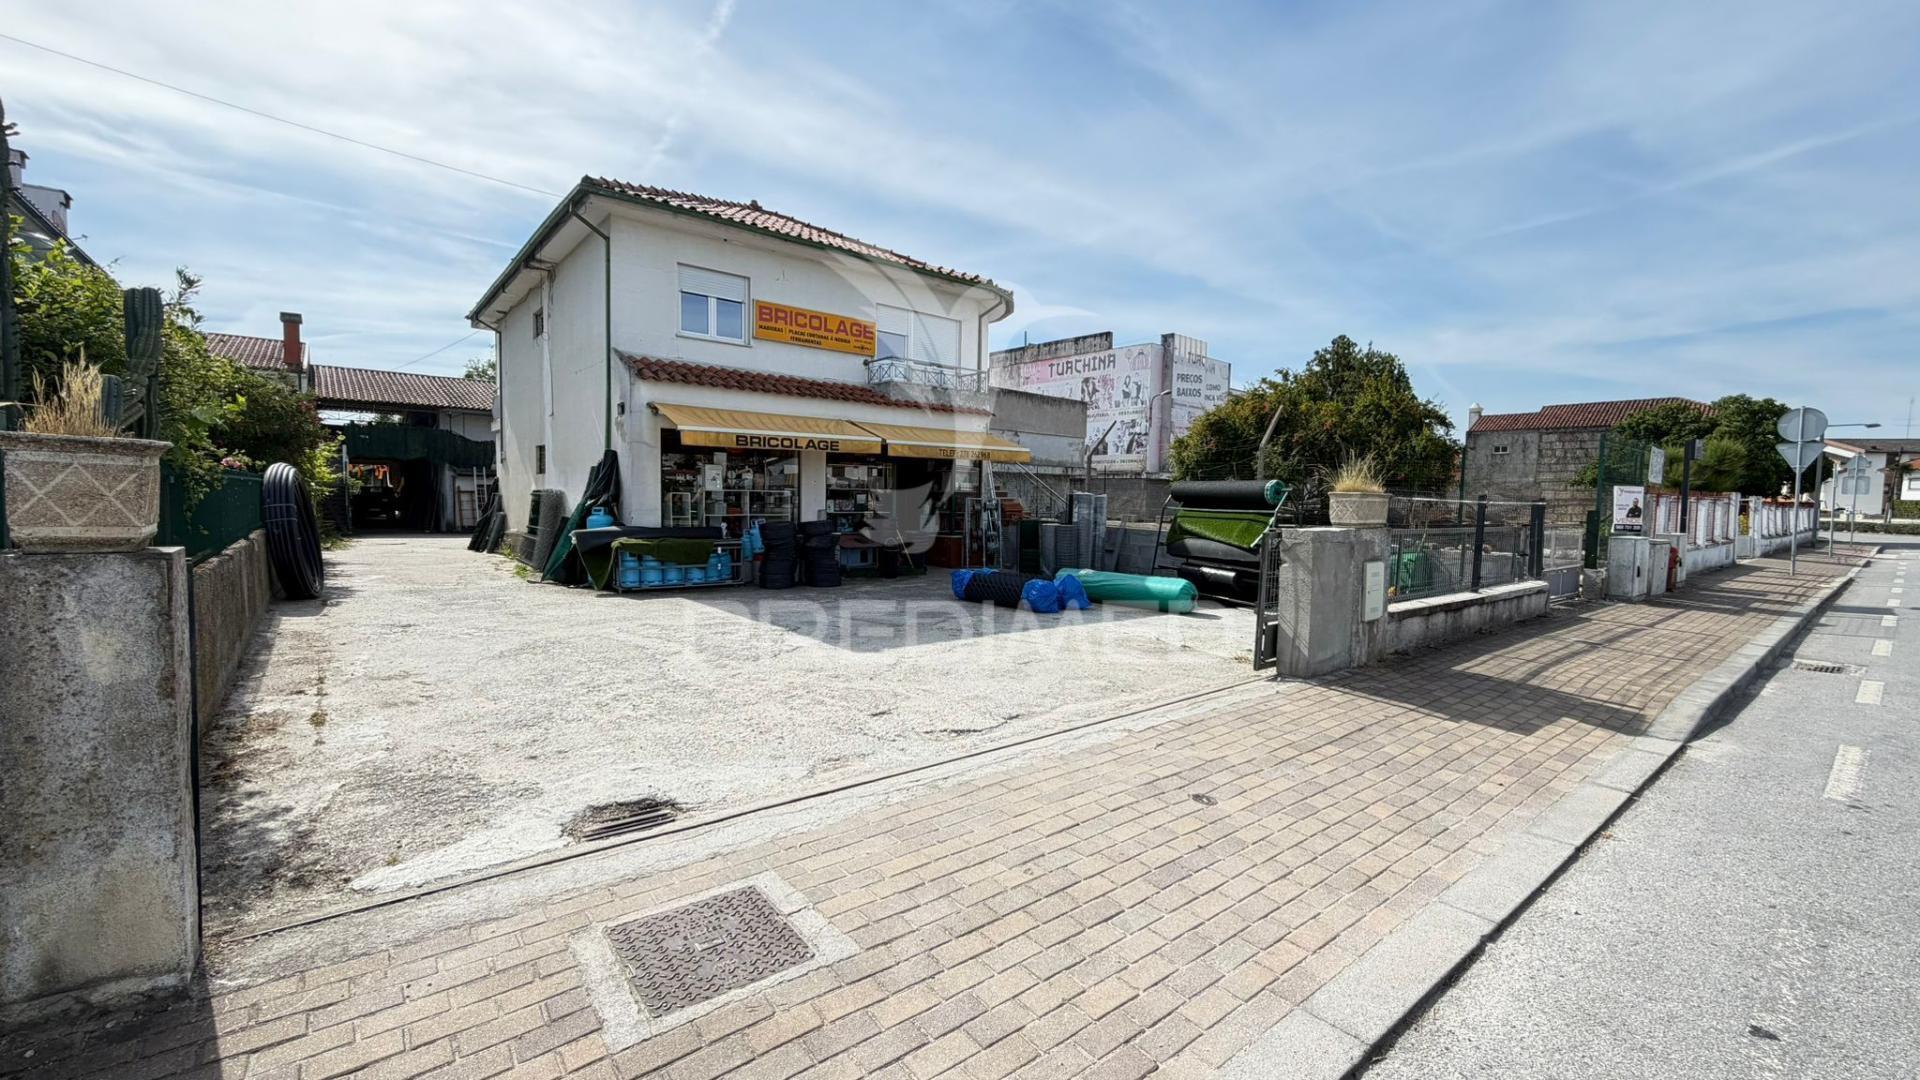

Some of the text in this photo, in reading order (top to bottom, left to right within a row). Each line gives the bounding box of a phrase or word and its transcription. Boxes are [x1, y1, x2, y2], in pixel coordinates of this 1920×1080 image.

[758, 305, 874, 340] BRICOLAGE
[1048, 353, 1116, 378] TUACHINA
[1176, 373, 1203, 386] PREÇOS
[1176, 387, 1202, 398] BAIXOS
[735, 434, 840, 451] BRICOLAGE
